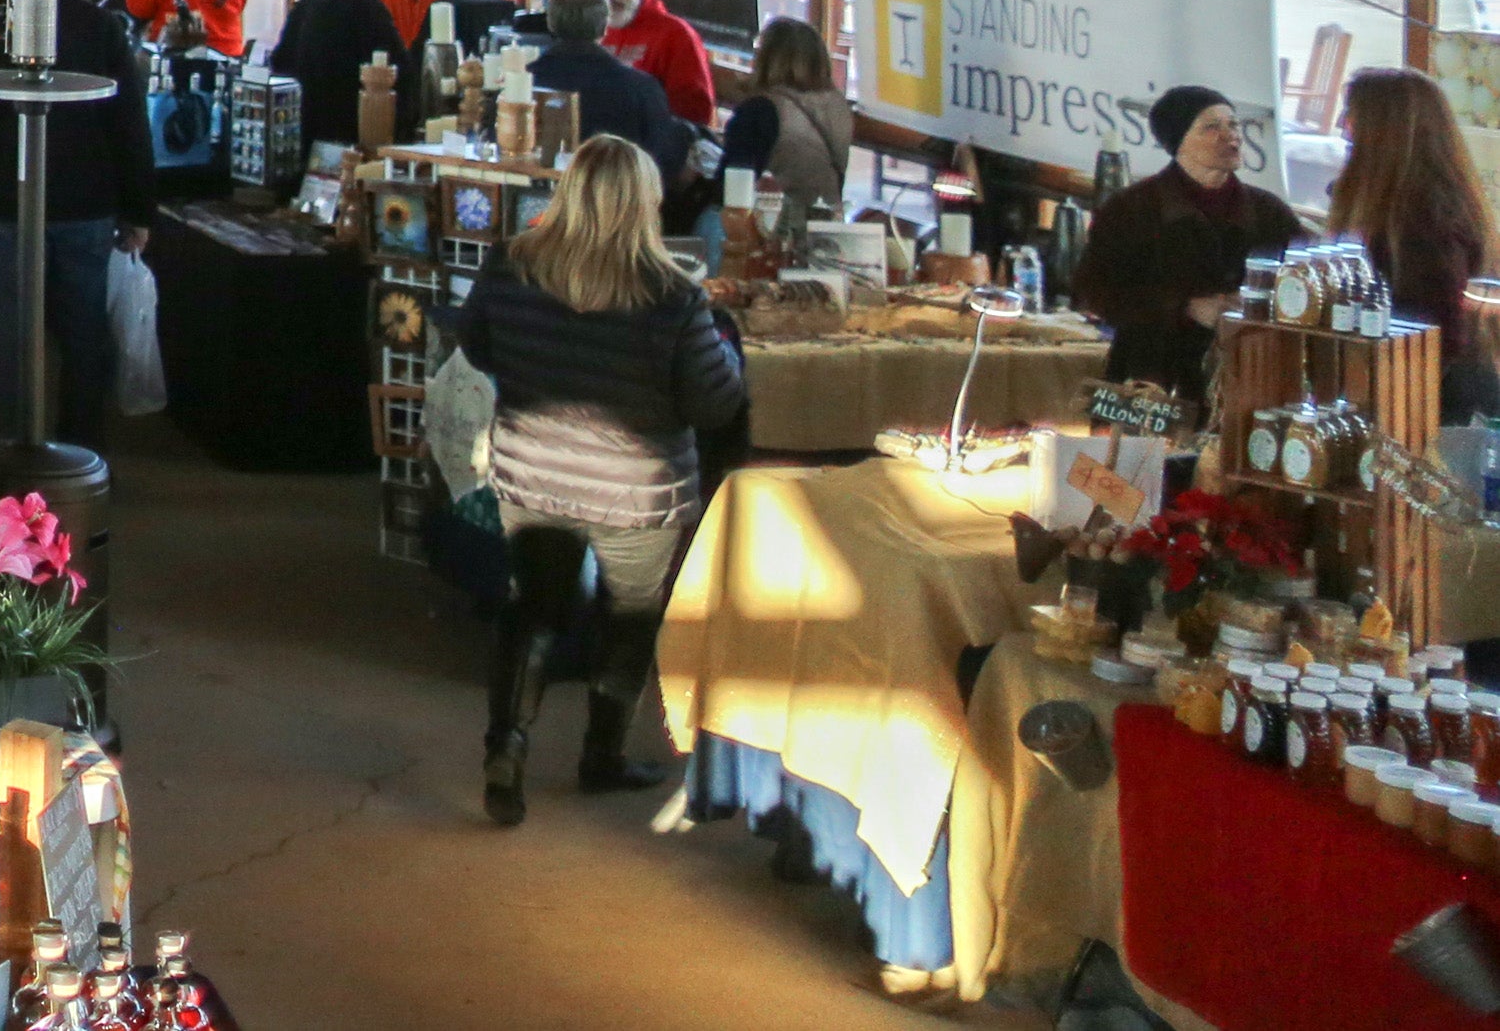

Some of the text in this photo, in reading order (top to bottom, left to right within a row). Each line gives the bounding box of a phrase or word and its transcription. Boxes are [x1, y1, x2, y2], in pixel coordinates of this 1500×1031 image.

[950, 44, 1268, 173] impresss
[1093, 388, 1119, 402] NO
[1091, 402, 1167, 432] ALLOWED
